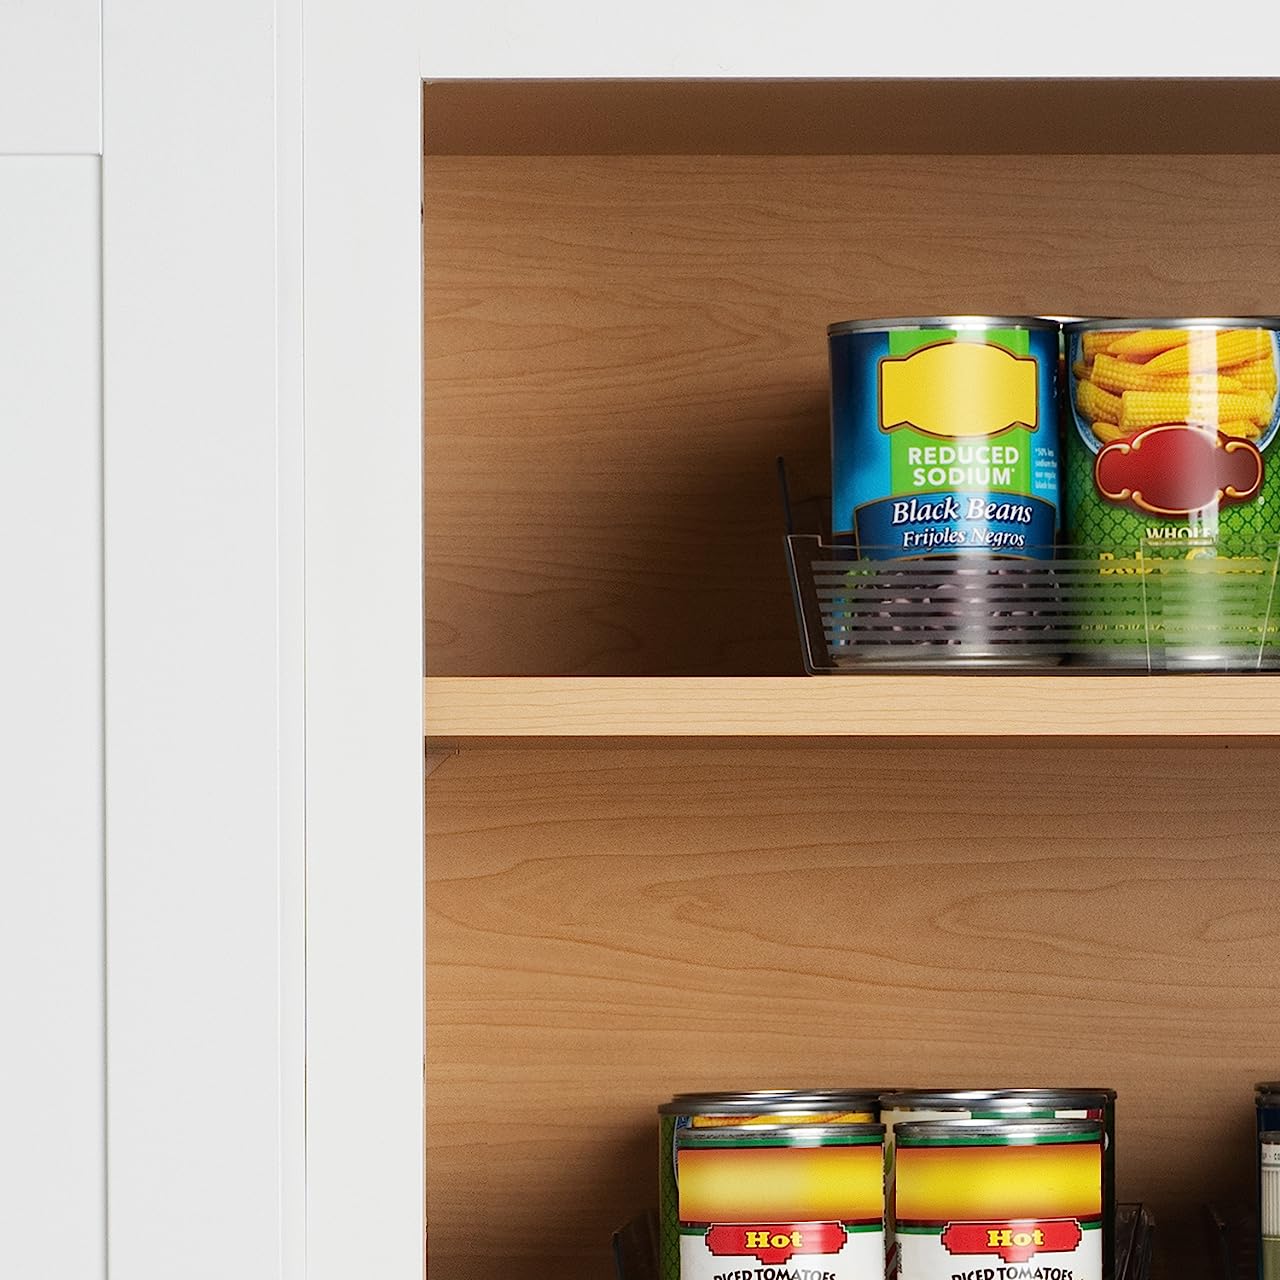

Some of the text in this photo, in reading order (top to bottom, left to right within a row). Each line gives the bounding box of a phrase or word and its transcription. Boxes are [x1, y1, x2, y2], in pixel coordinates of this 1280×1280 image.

[908, 447, 1019, 465] REDUCED
[892, 496, 1033, 525] Black Beans
[903, 526, 1025, 550] Frijoles Negros
[745, 1231, 803, 1249] Hot
[987, 1229, 1045, 1247] Hot
